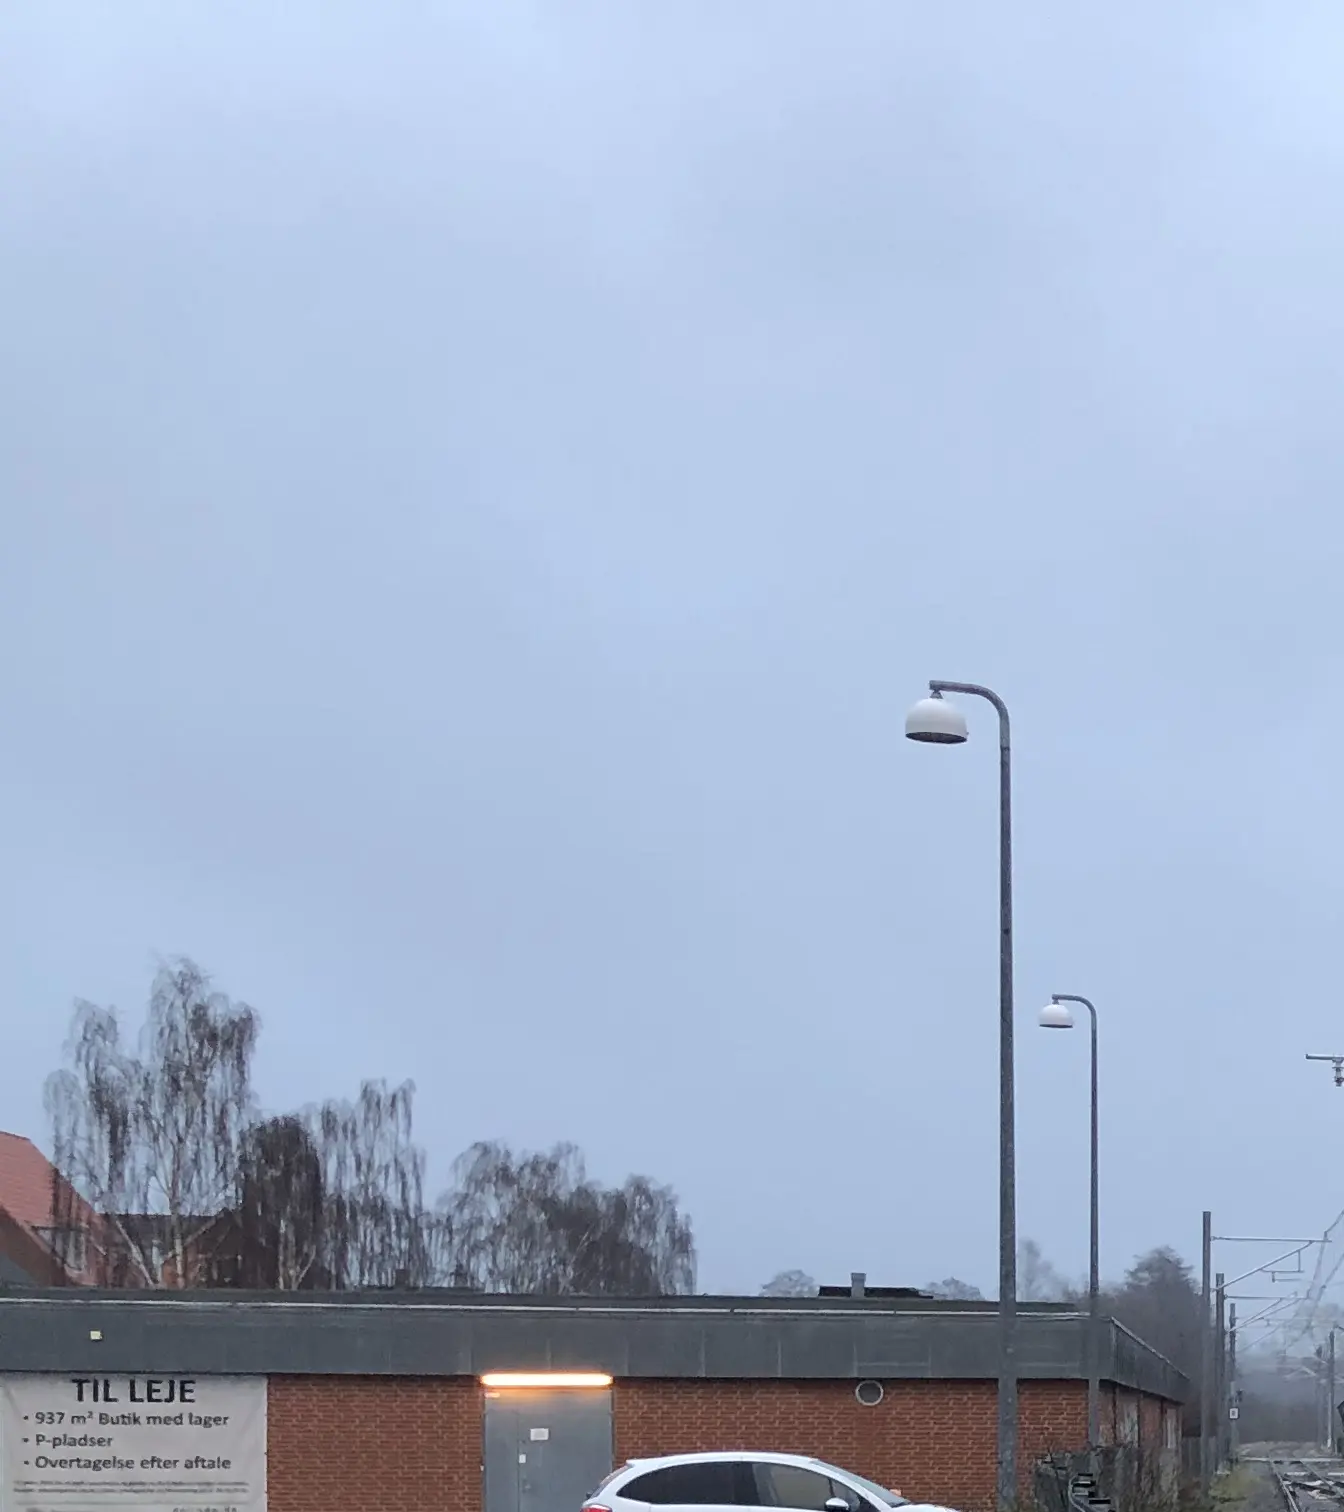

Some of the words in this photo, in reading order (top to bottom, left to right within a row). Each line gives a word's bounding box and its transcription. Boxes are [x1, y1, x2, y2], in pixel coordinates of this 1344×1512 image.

[71, 1378, 119, 1404] TIL
[129, 1378, 196, 1404] LEJE
[34, 1411, 65, 1425] 937
[99, 1411, 141, 1426] Butik
[146, 1412, 184, 1426] med
[188, 1412, 230, 1429] lager
[35, 1433, 113, 1449] P-pladser
[35, 1455, 135, 1471] Overtagelse
[140, 1455, 180, 1470] efter
[184, 1455, 231, 1470] aftale
